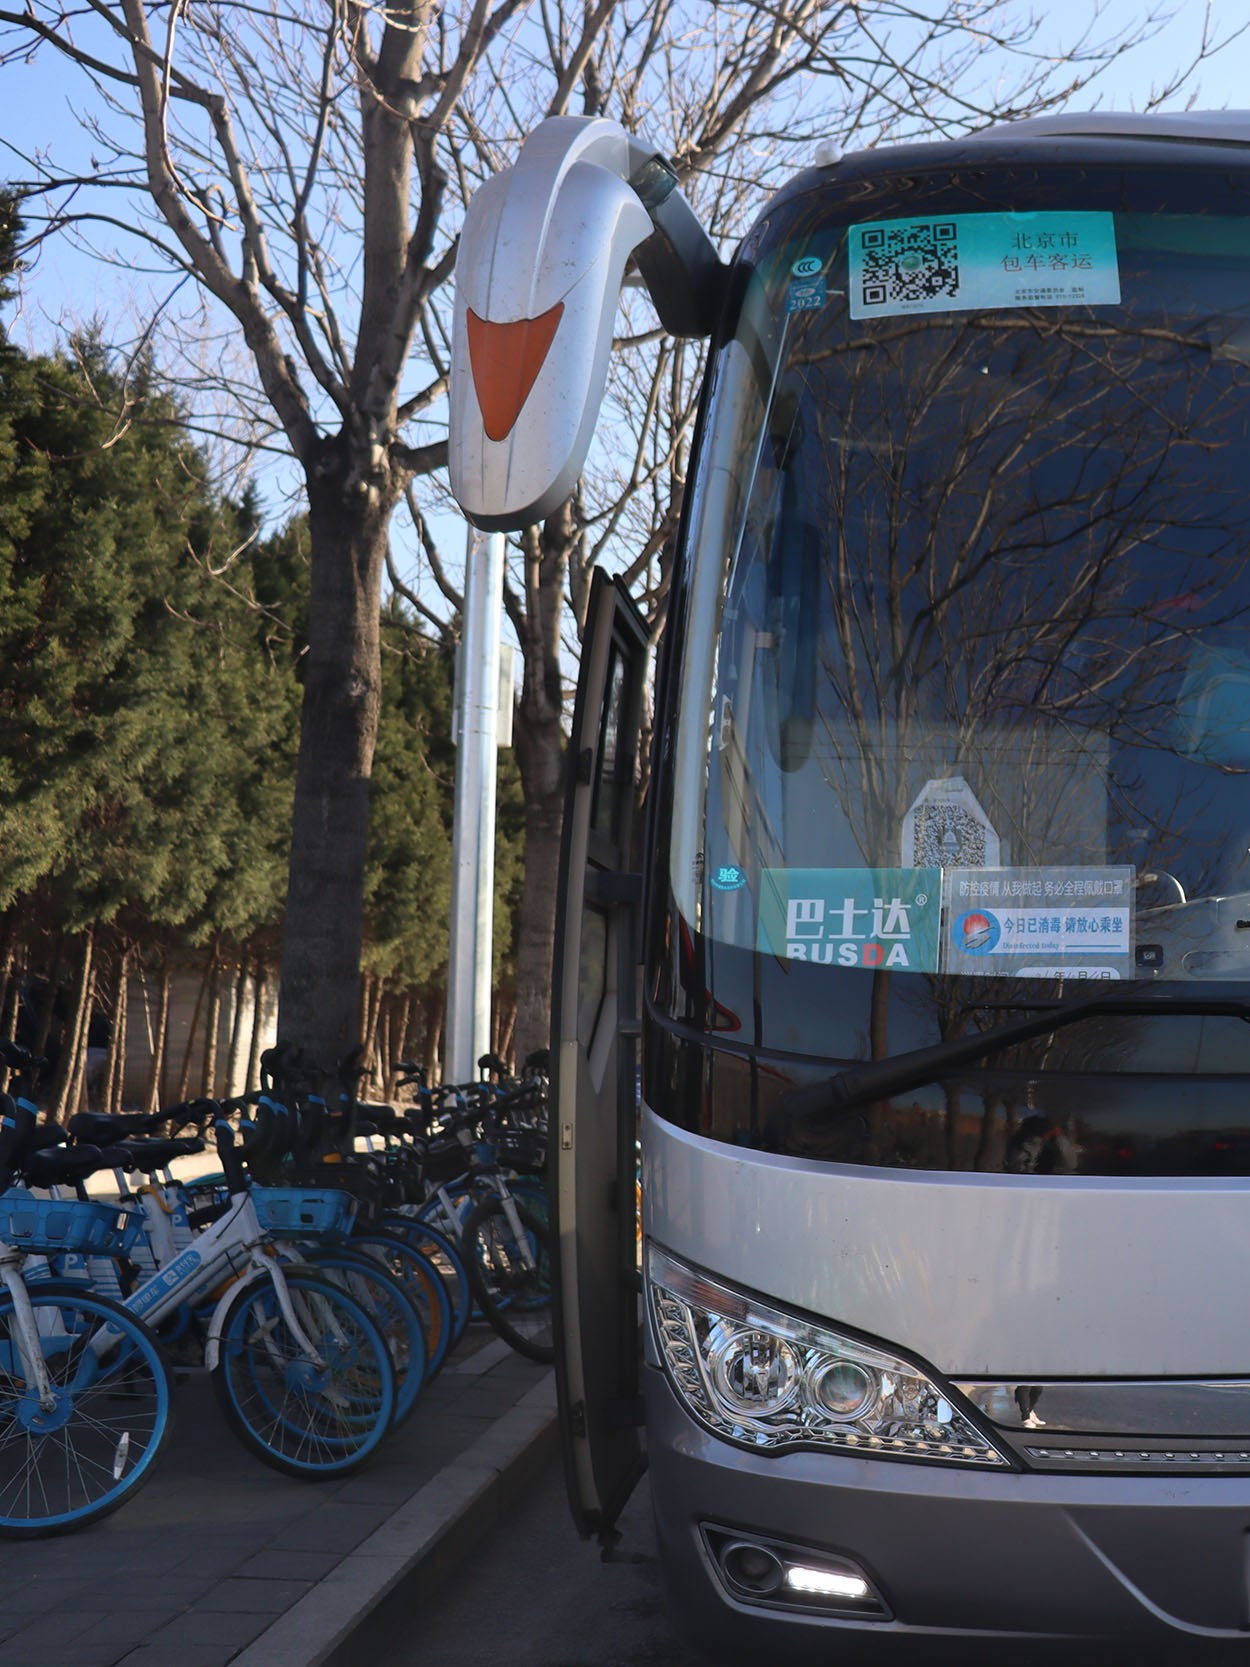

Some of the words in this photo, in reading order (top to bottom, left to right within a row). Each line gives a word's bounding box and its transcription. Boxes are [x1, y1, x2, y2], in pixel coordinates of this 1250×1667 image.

[1011, 232, 1079, 249] 北京市
[1001, 253, 1094, 272] 包车客运
[790, 296, 821, 310] 2022
[718, 868, 739, 882] 验
[959, 881, 999, 897] 防控疫情
[1001, 881, 1041, 897] 从我做起
[786, 898, 912, 939] 巴士达
[1004, 917, 1061, 934] 今日已消毒
[1065, 916, 1123, 933] 请放心乘坐
[786, 943, 910, 966] BUSDA
